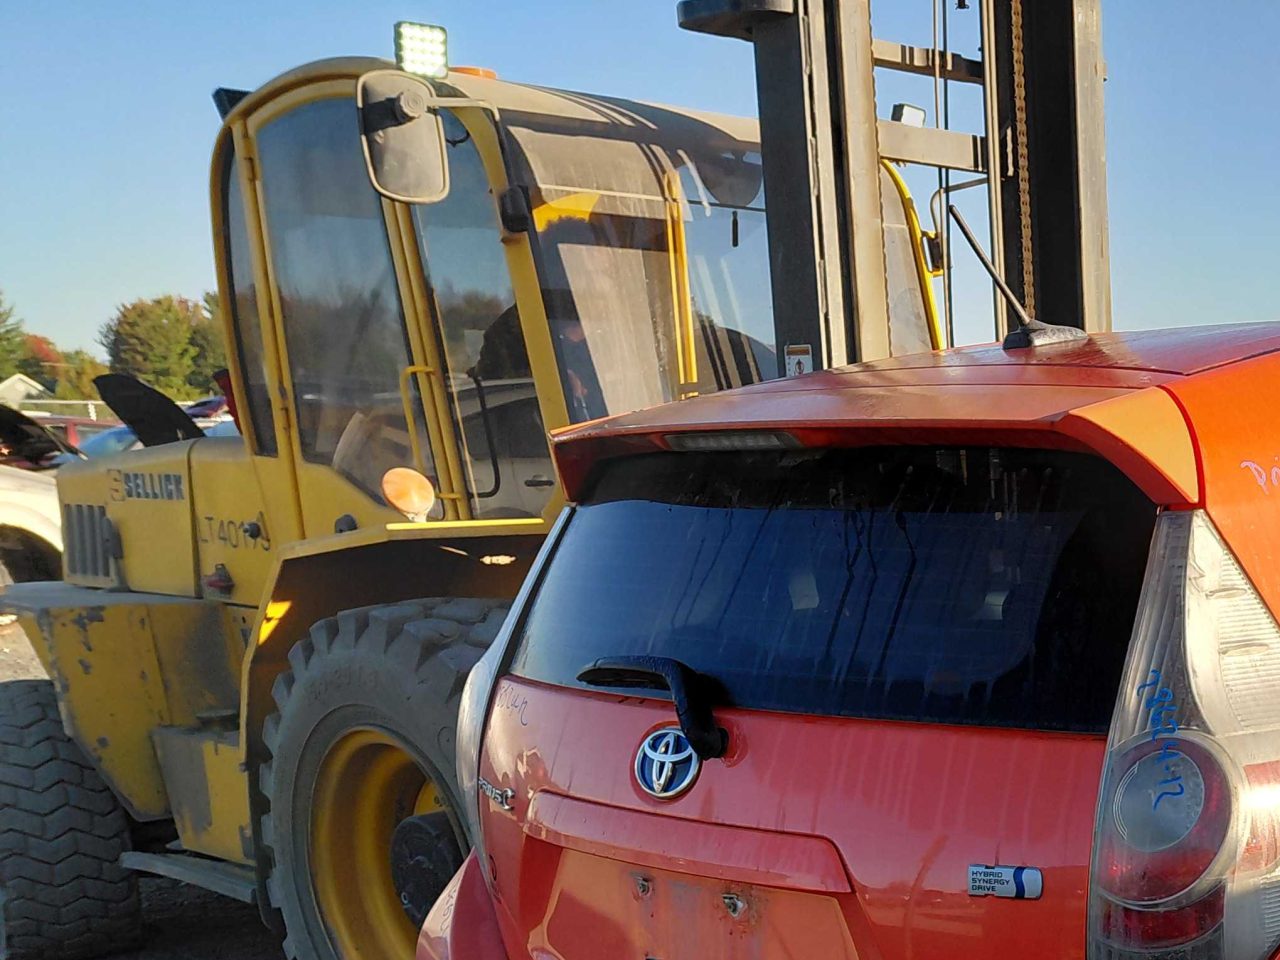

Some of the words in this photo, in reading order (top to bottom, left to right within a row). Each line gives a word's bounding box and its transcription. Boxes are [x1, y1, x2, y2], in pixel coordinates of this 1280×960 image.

[124, 472, 184, 500] SELLICK
[971, 870, 1003, 878] HYBRID
[971, 877, 1010, 886] SYNERGY
[971, 884, 997, 892] DRIVE
